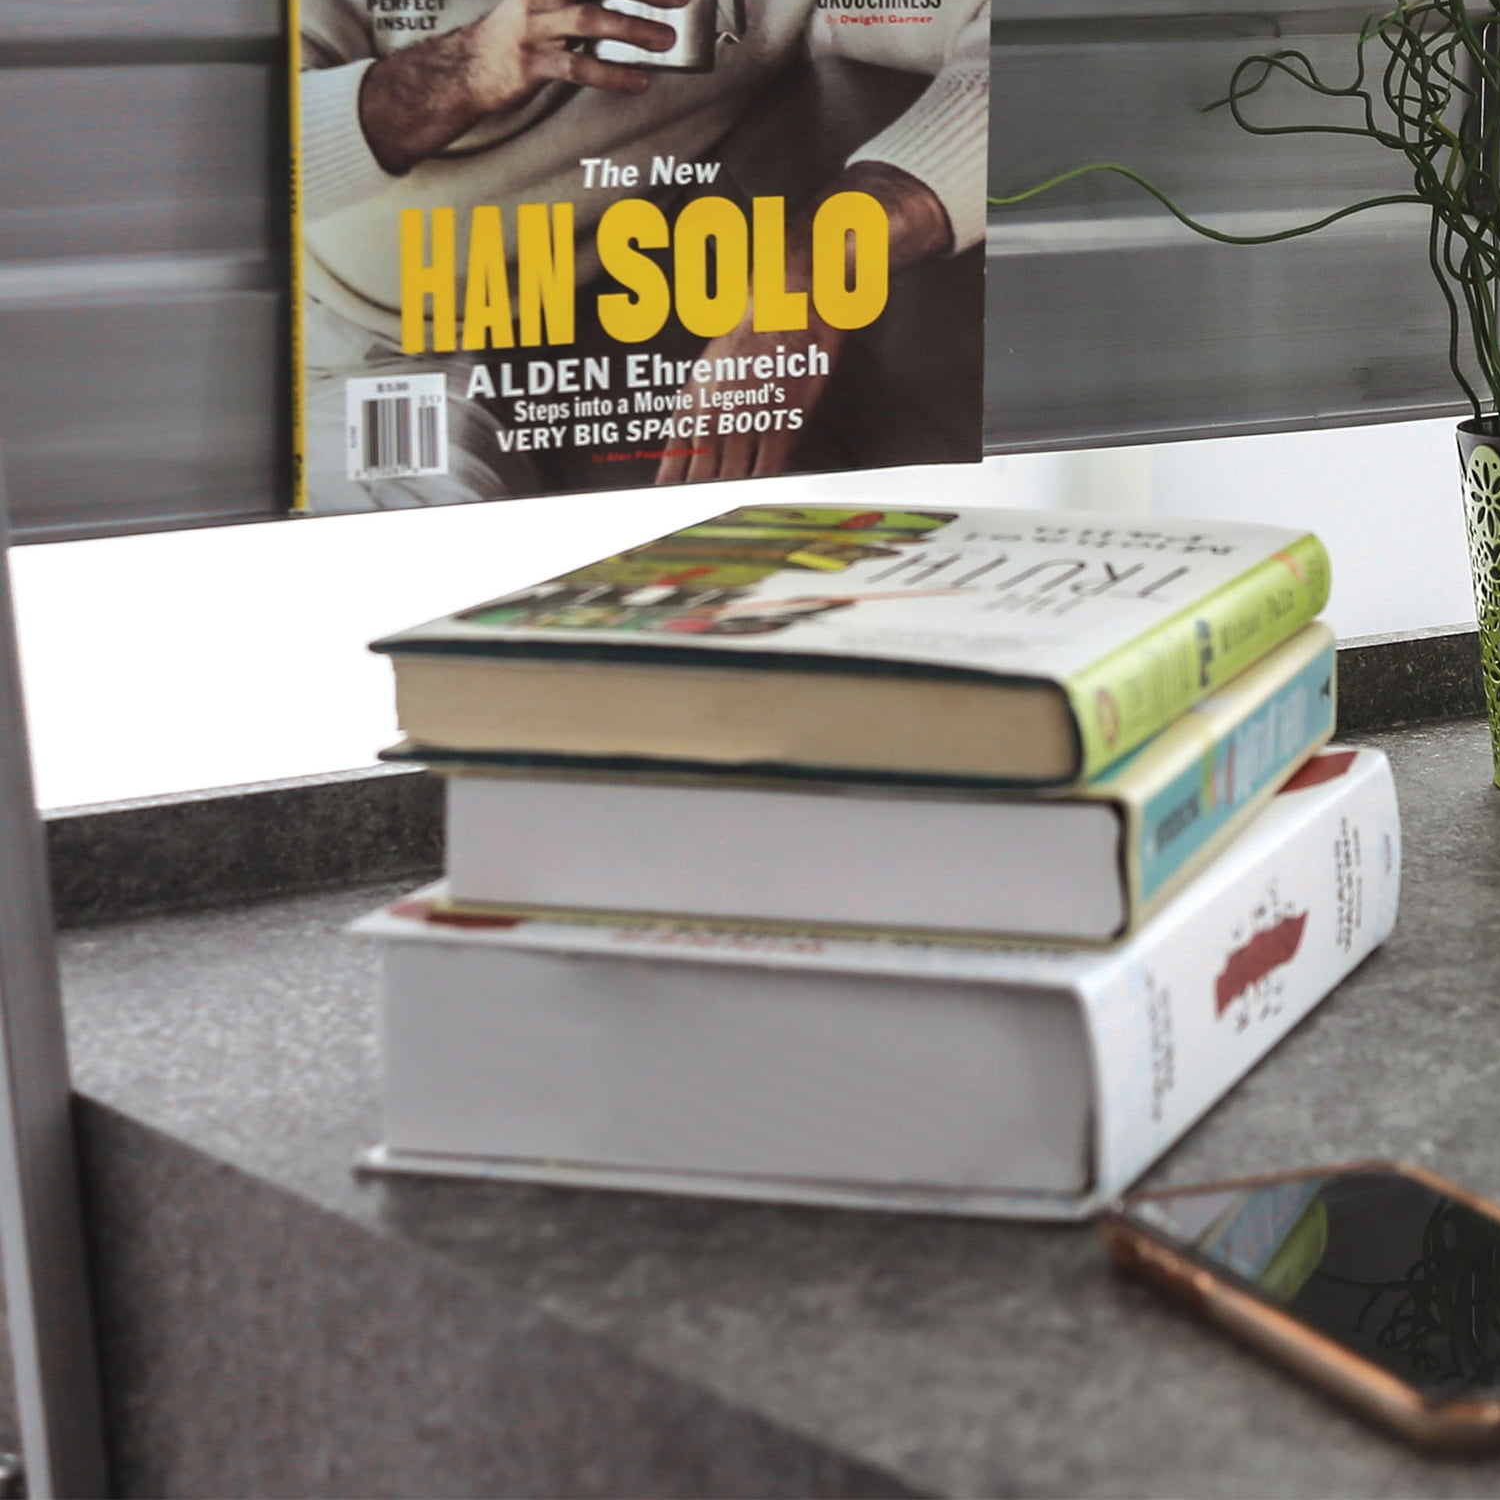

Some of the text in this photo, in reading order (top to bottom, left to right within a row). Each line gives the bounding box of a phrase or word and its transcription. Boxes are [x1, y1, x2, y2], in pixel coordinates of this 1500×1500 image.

[377, 16, 438, 31] INSULT
[840, 14, 884, 26] Dwight
[888, 14, 933, 24] Garner
[580, 155, 721, 189] The New
[400, 201, 576, 354] HAN
[596, 190, 890, 344] SOLO
[466, 344, 830, 400] ALDEN Ehrenreich
[513, 383, 785, 424] Steps into a Movie Legend's
[496, 408, 804, 453] VERY BIG SPACE BOOTS
